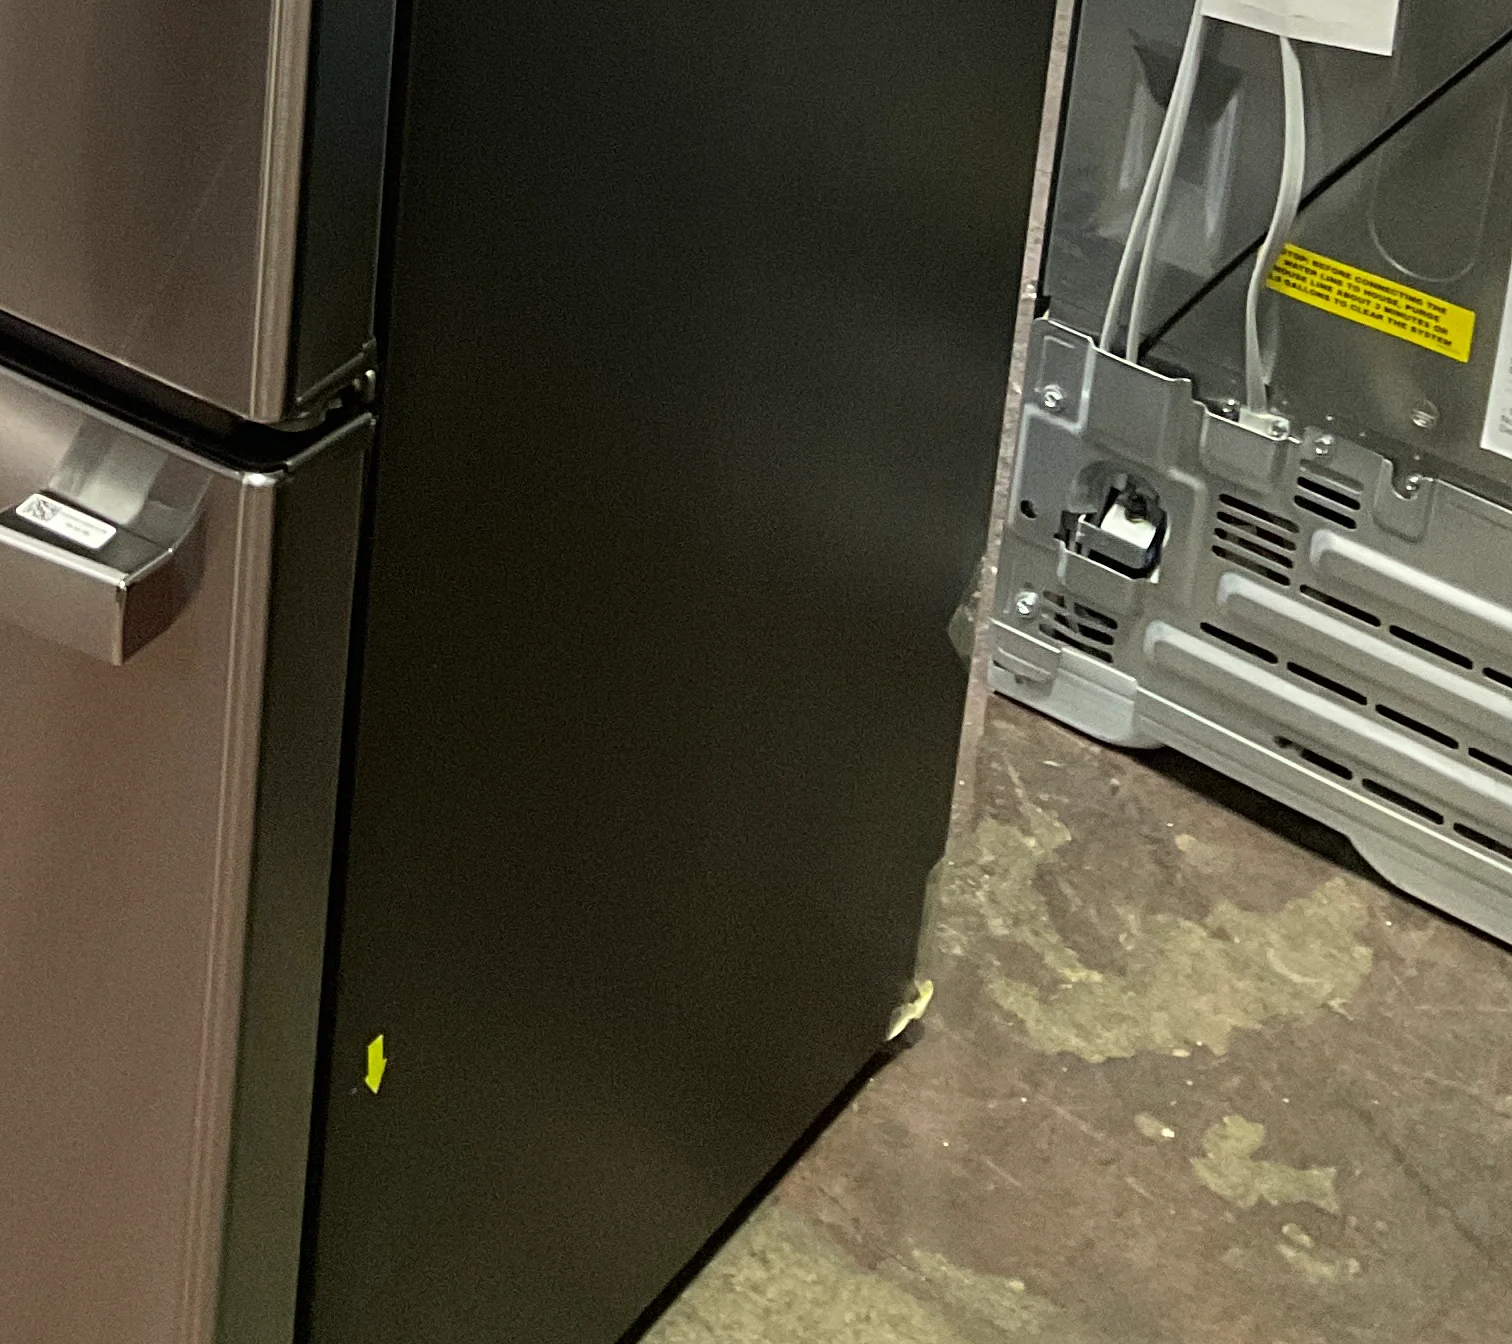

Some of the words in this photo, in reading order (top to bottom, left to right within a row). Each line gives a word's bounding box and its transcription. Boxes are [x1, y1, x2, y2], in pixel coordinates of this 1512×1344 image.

[1282, 258, 1318, 276] WATER
[1319, 272, 1344, 286] LINE
[1345, 282, 1361, 293] TO
[1404, 303, 1440, 323] PURGE
[1425, 301, 1447, 315] THE
[1333, 297, 1347, 308] TO
[1349, 303, 1384, 322] CLEAR
[1387, 317, 1407, 330] THE
[1336, 288, 1371, 307] ABOUT
[1432, 324, 1448, 336] OR
